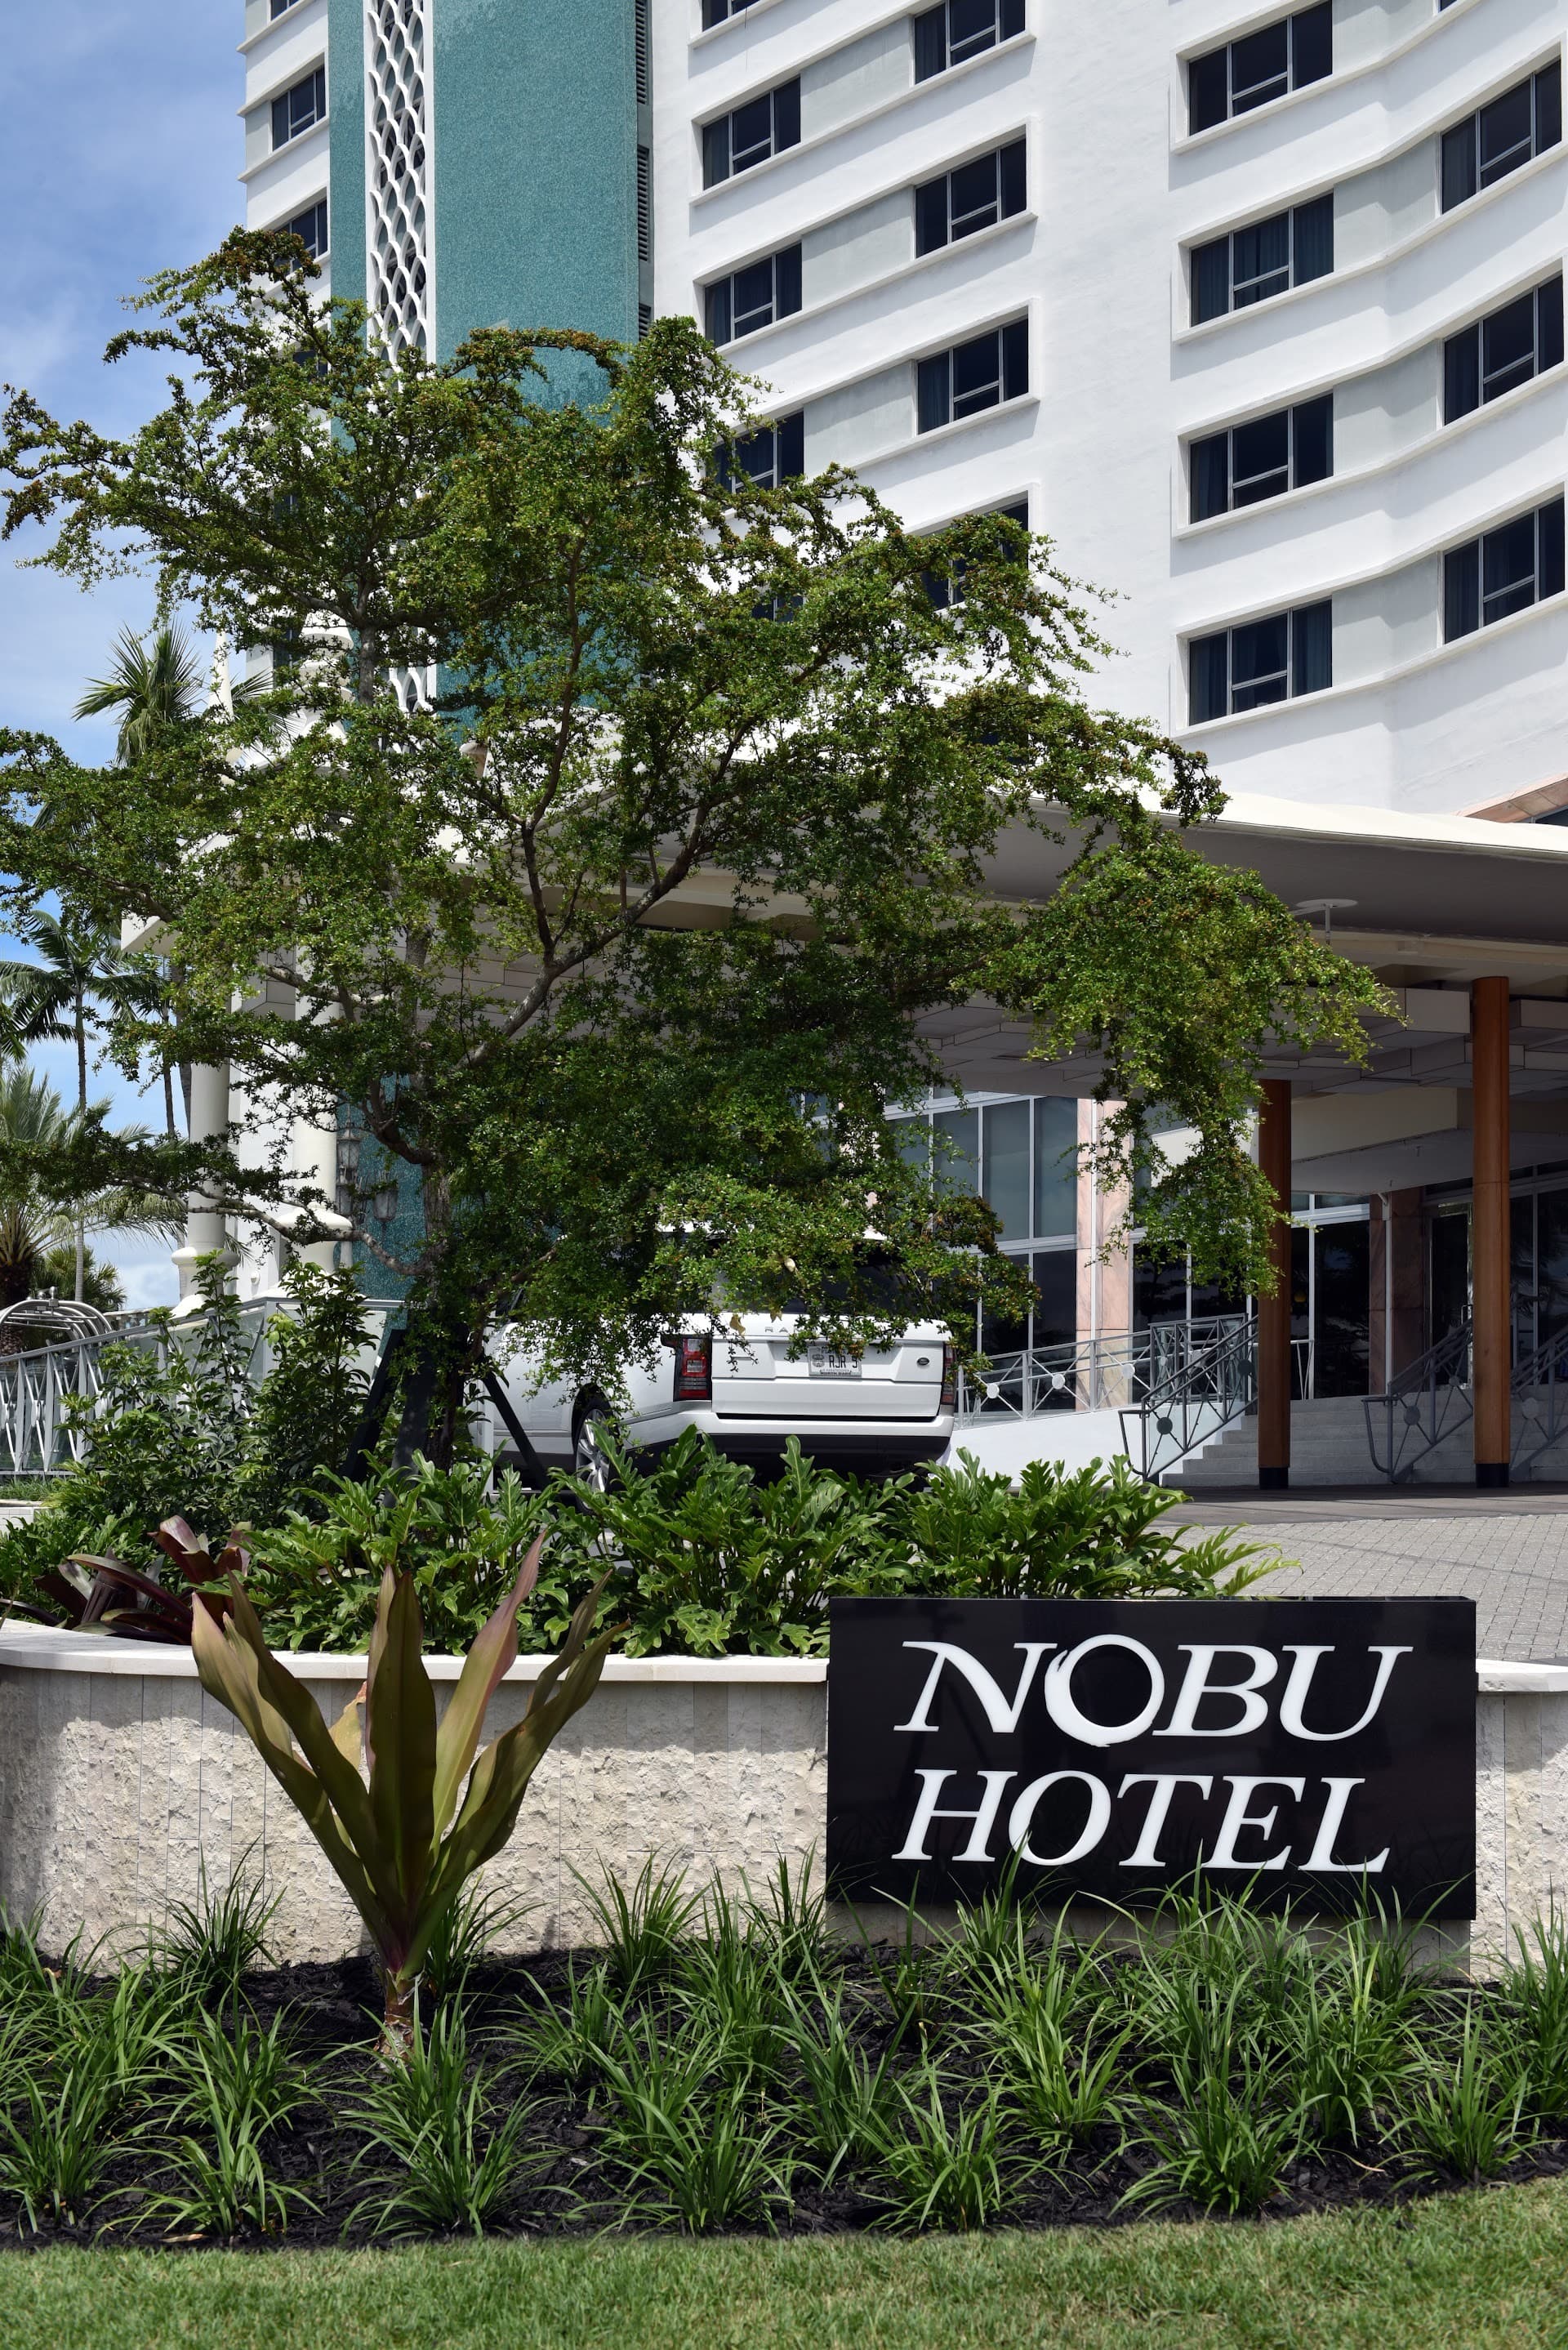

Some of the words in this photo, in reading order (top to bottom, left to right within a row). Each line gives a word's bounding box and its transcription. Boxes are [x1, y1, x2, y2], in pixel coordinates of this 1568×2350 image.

[829, 1354, 846, 1368] RJR
[893, 1634, 1413, 1746] NOBU
[892, 1768, 1390, 1873] HOTEL
